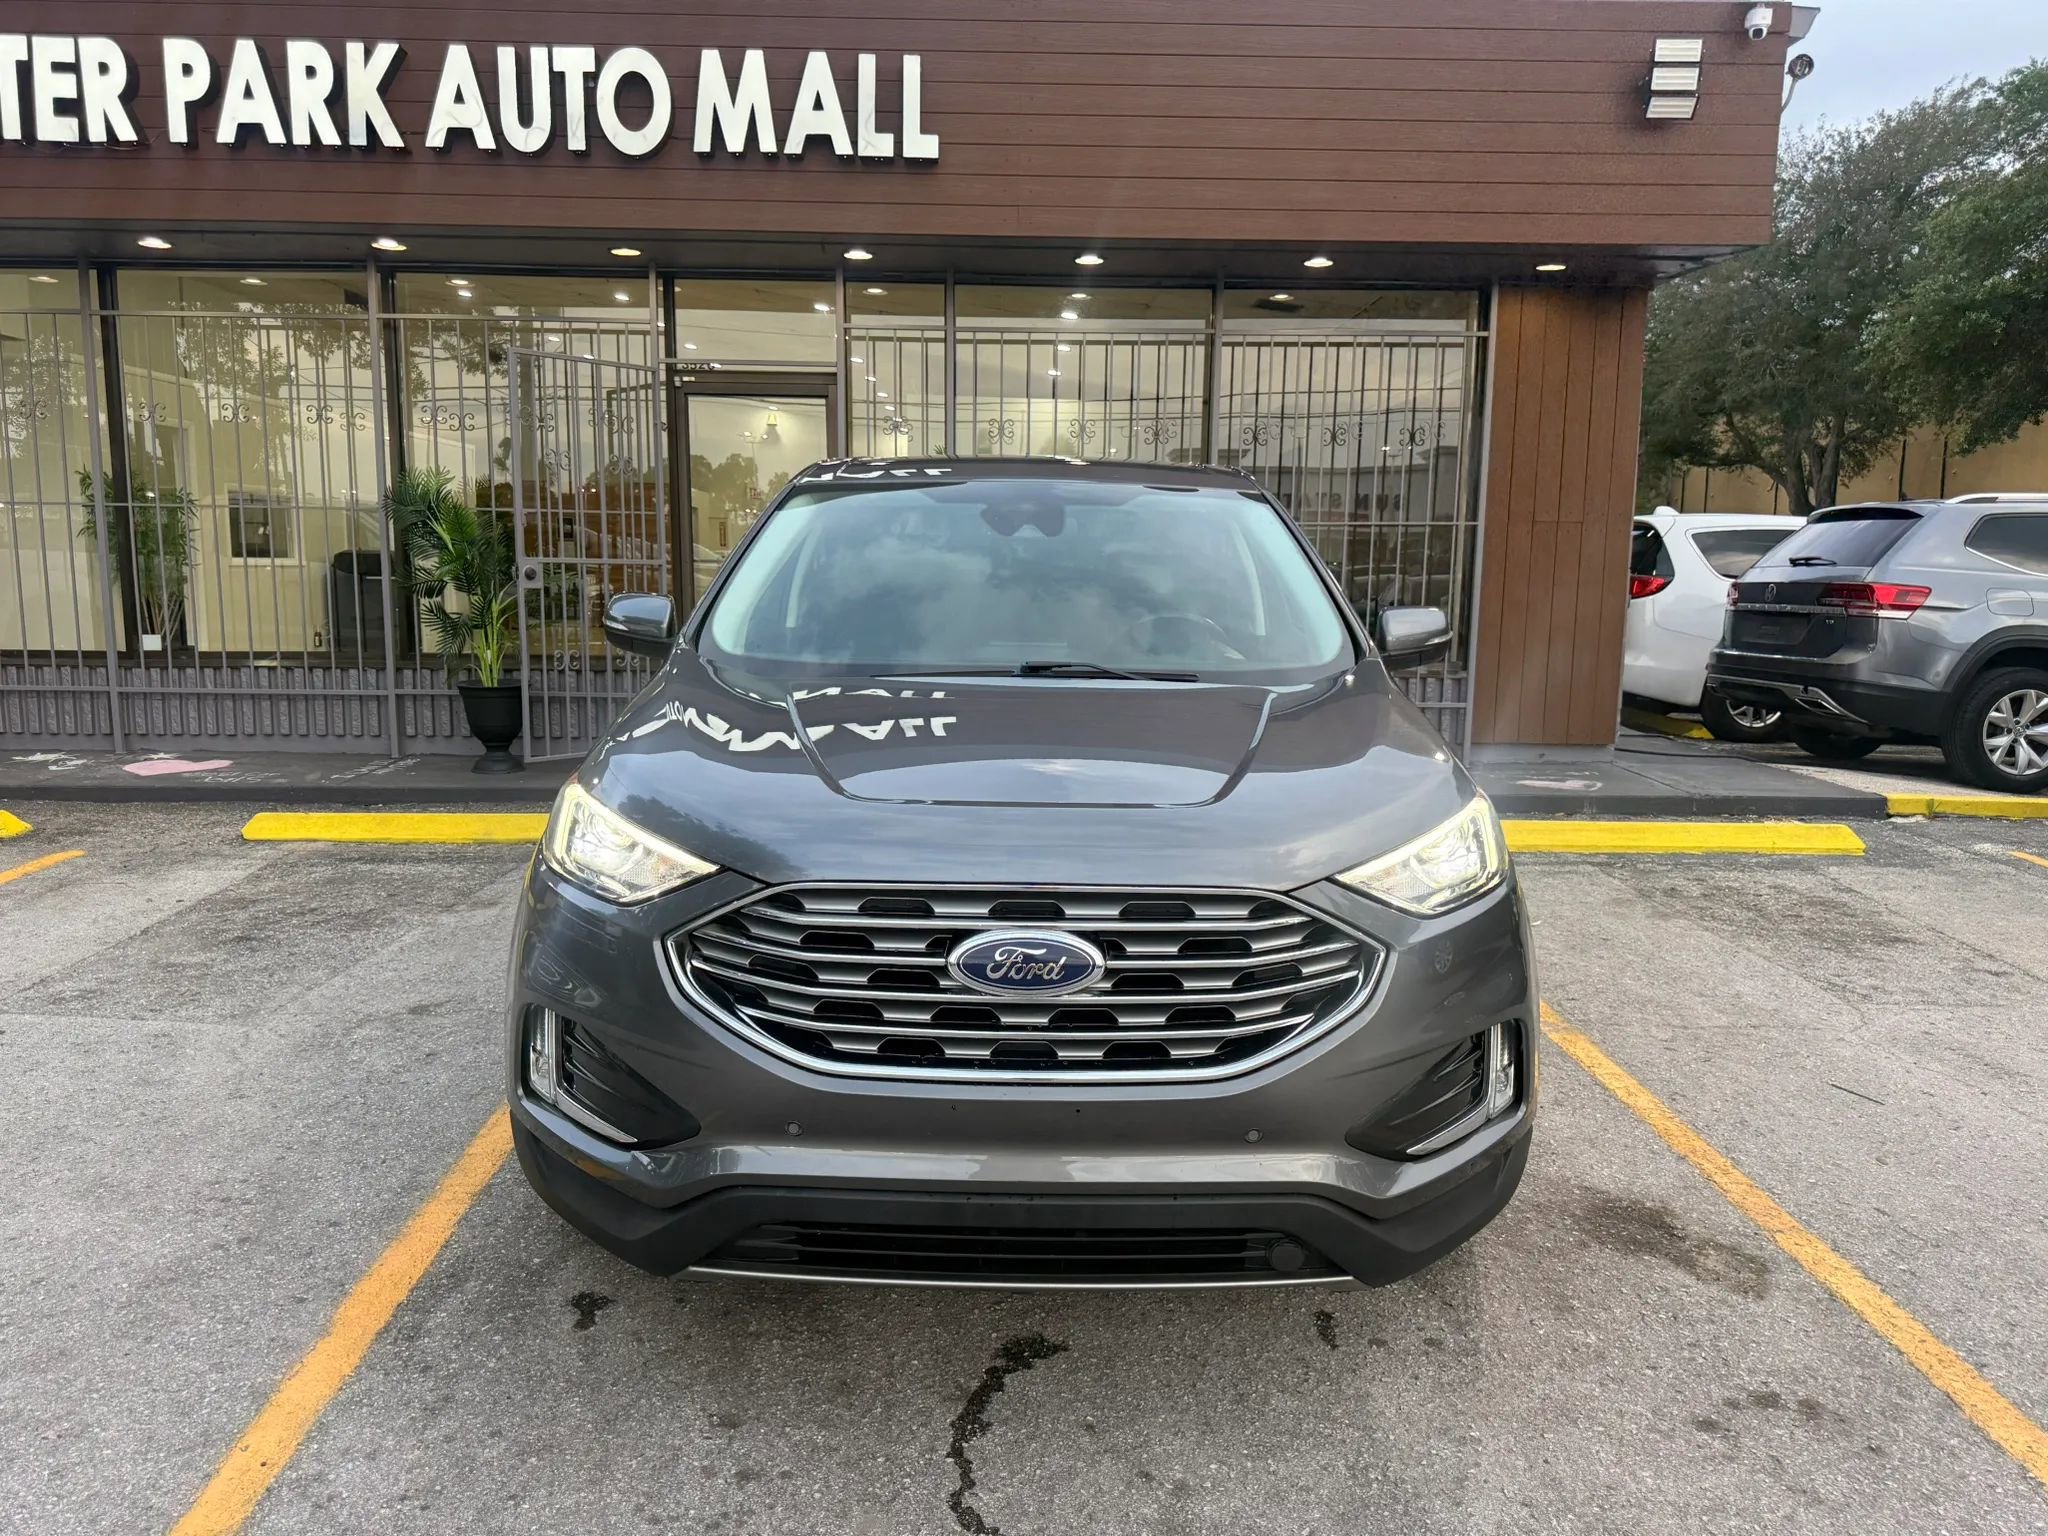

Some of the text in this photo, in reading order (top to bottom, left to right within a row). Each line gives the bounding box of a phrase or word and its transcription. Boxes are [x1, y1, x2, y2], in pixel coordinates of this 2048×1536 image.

[0, 35, 940, 160] TER PARK AUTO MALL
[986, 946, 1067, 981] Ford
